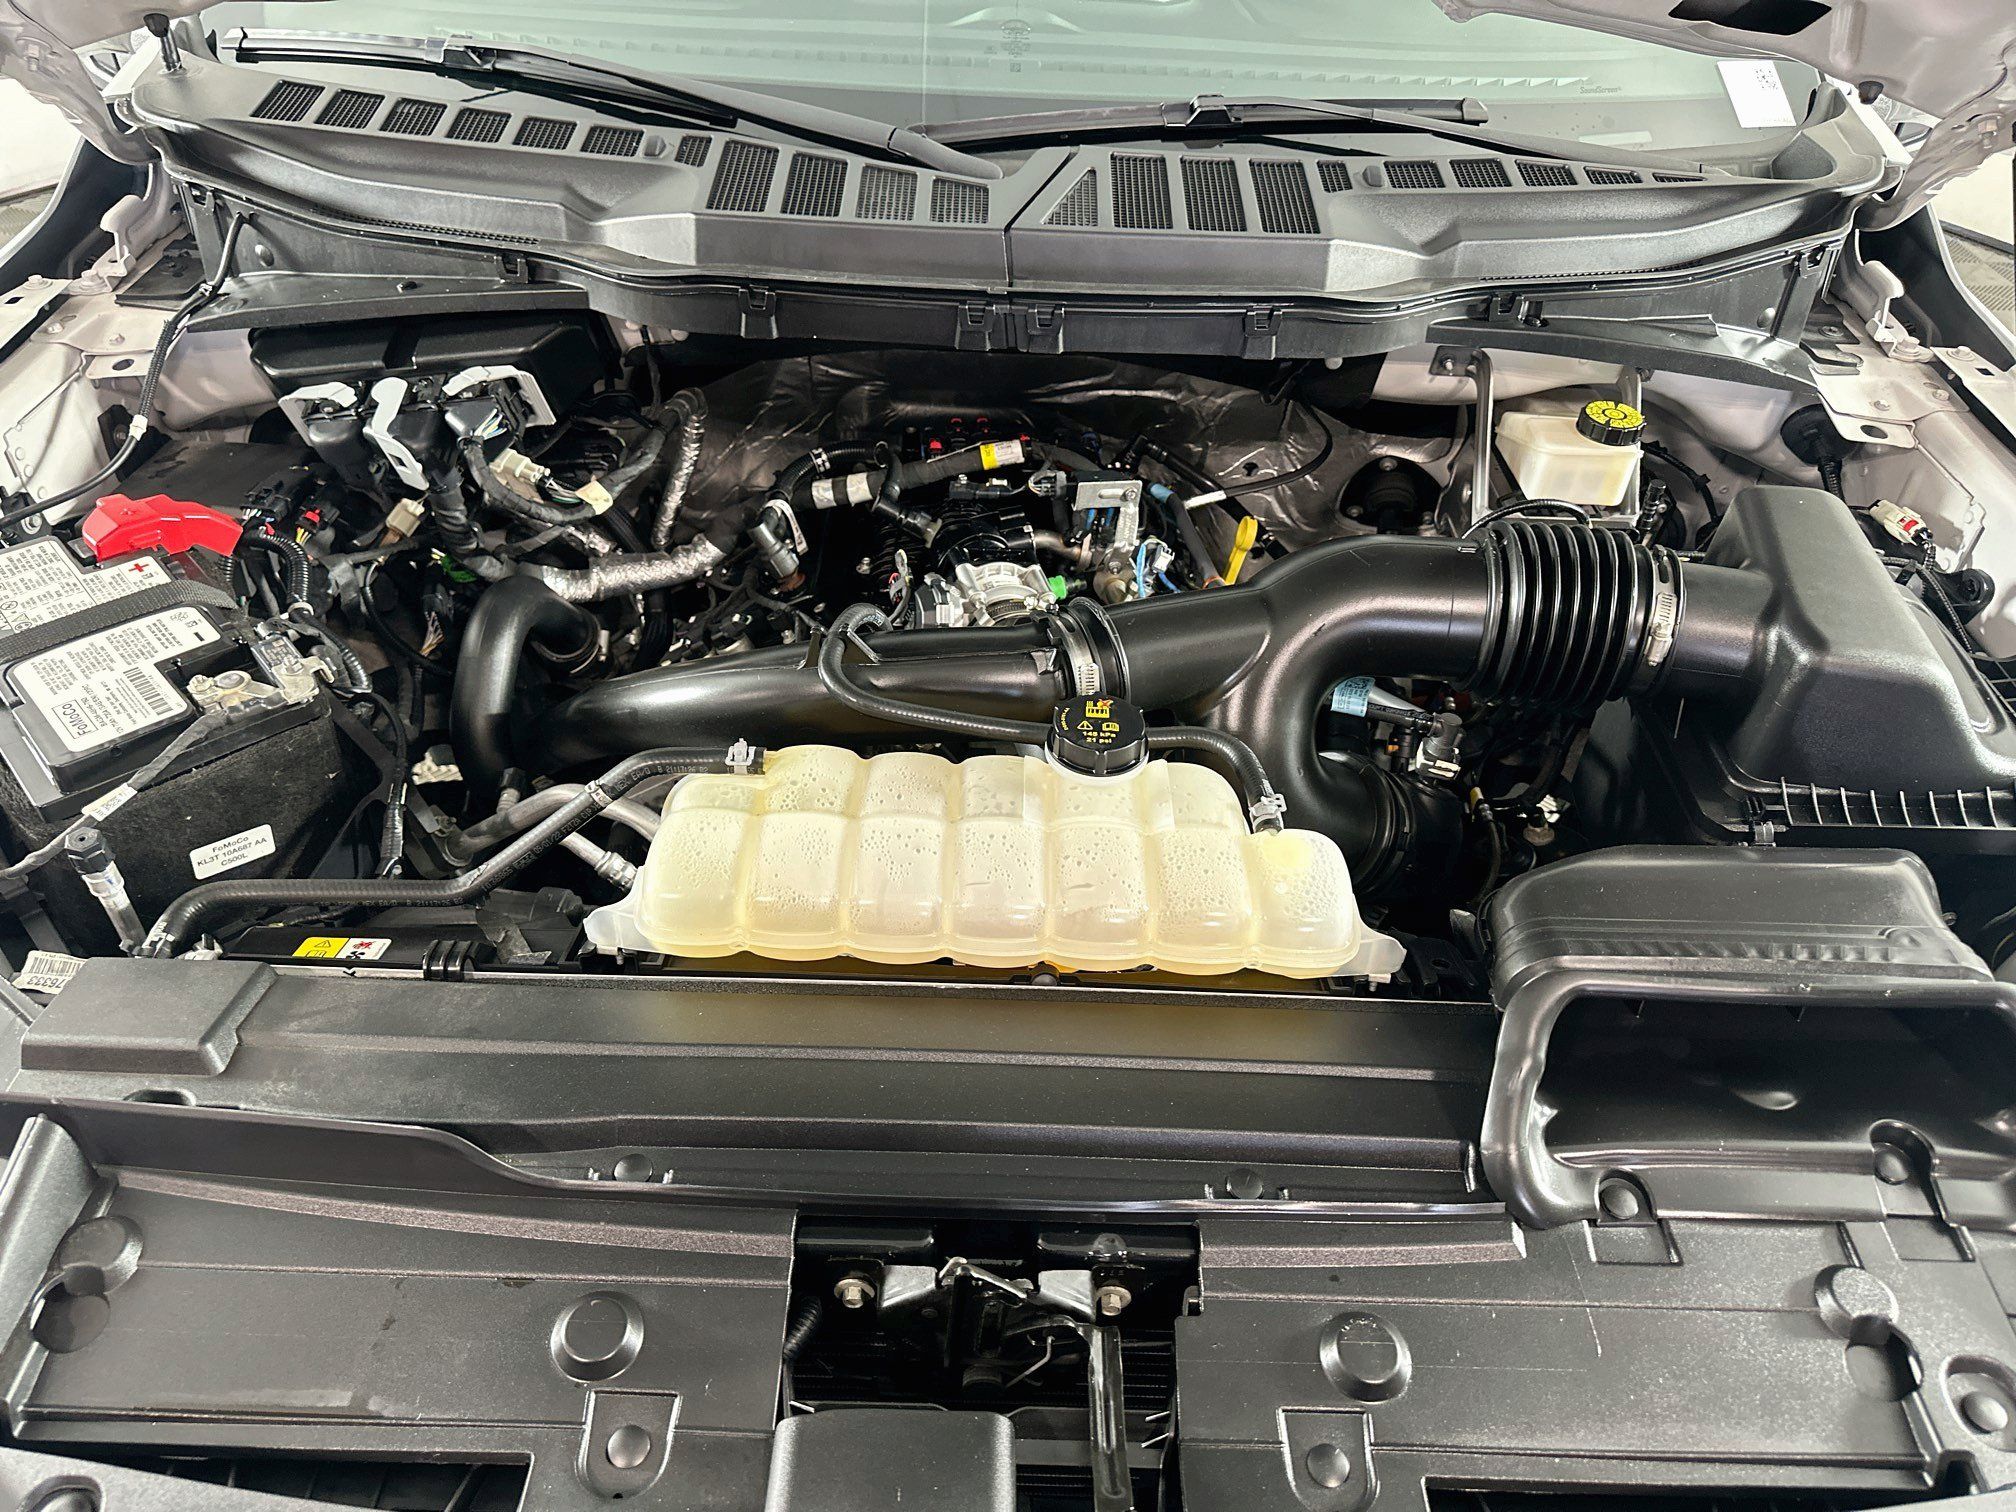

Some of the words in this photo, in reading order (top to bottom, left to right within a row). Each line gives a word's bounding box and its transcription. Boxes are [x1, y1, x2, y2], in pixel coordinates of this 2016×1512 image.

[62, 703, 92, 736] FoMoCo
[197, 854, 220, 866] KL3T
[254, 837, 268, 846] AA
[212, 836, 249, 852] FoMoCo
[27, 975, 66, 989] 76333
